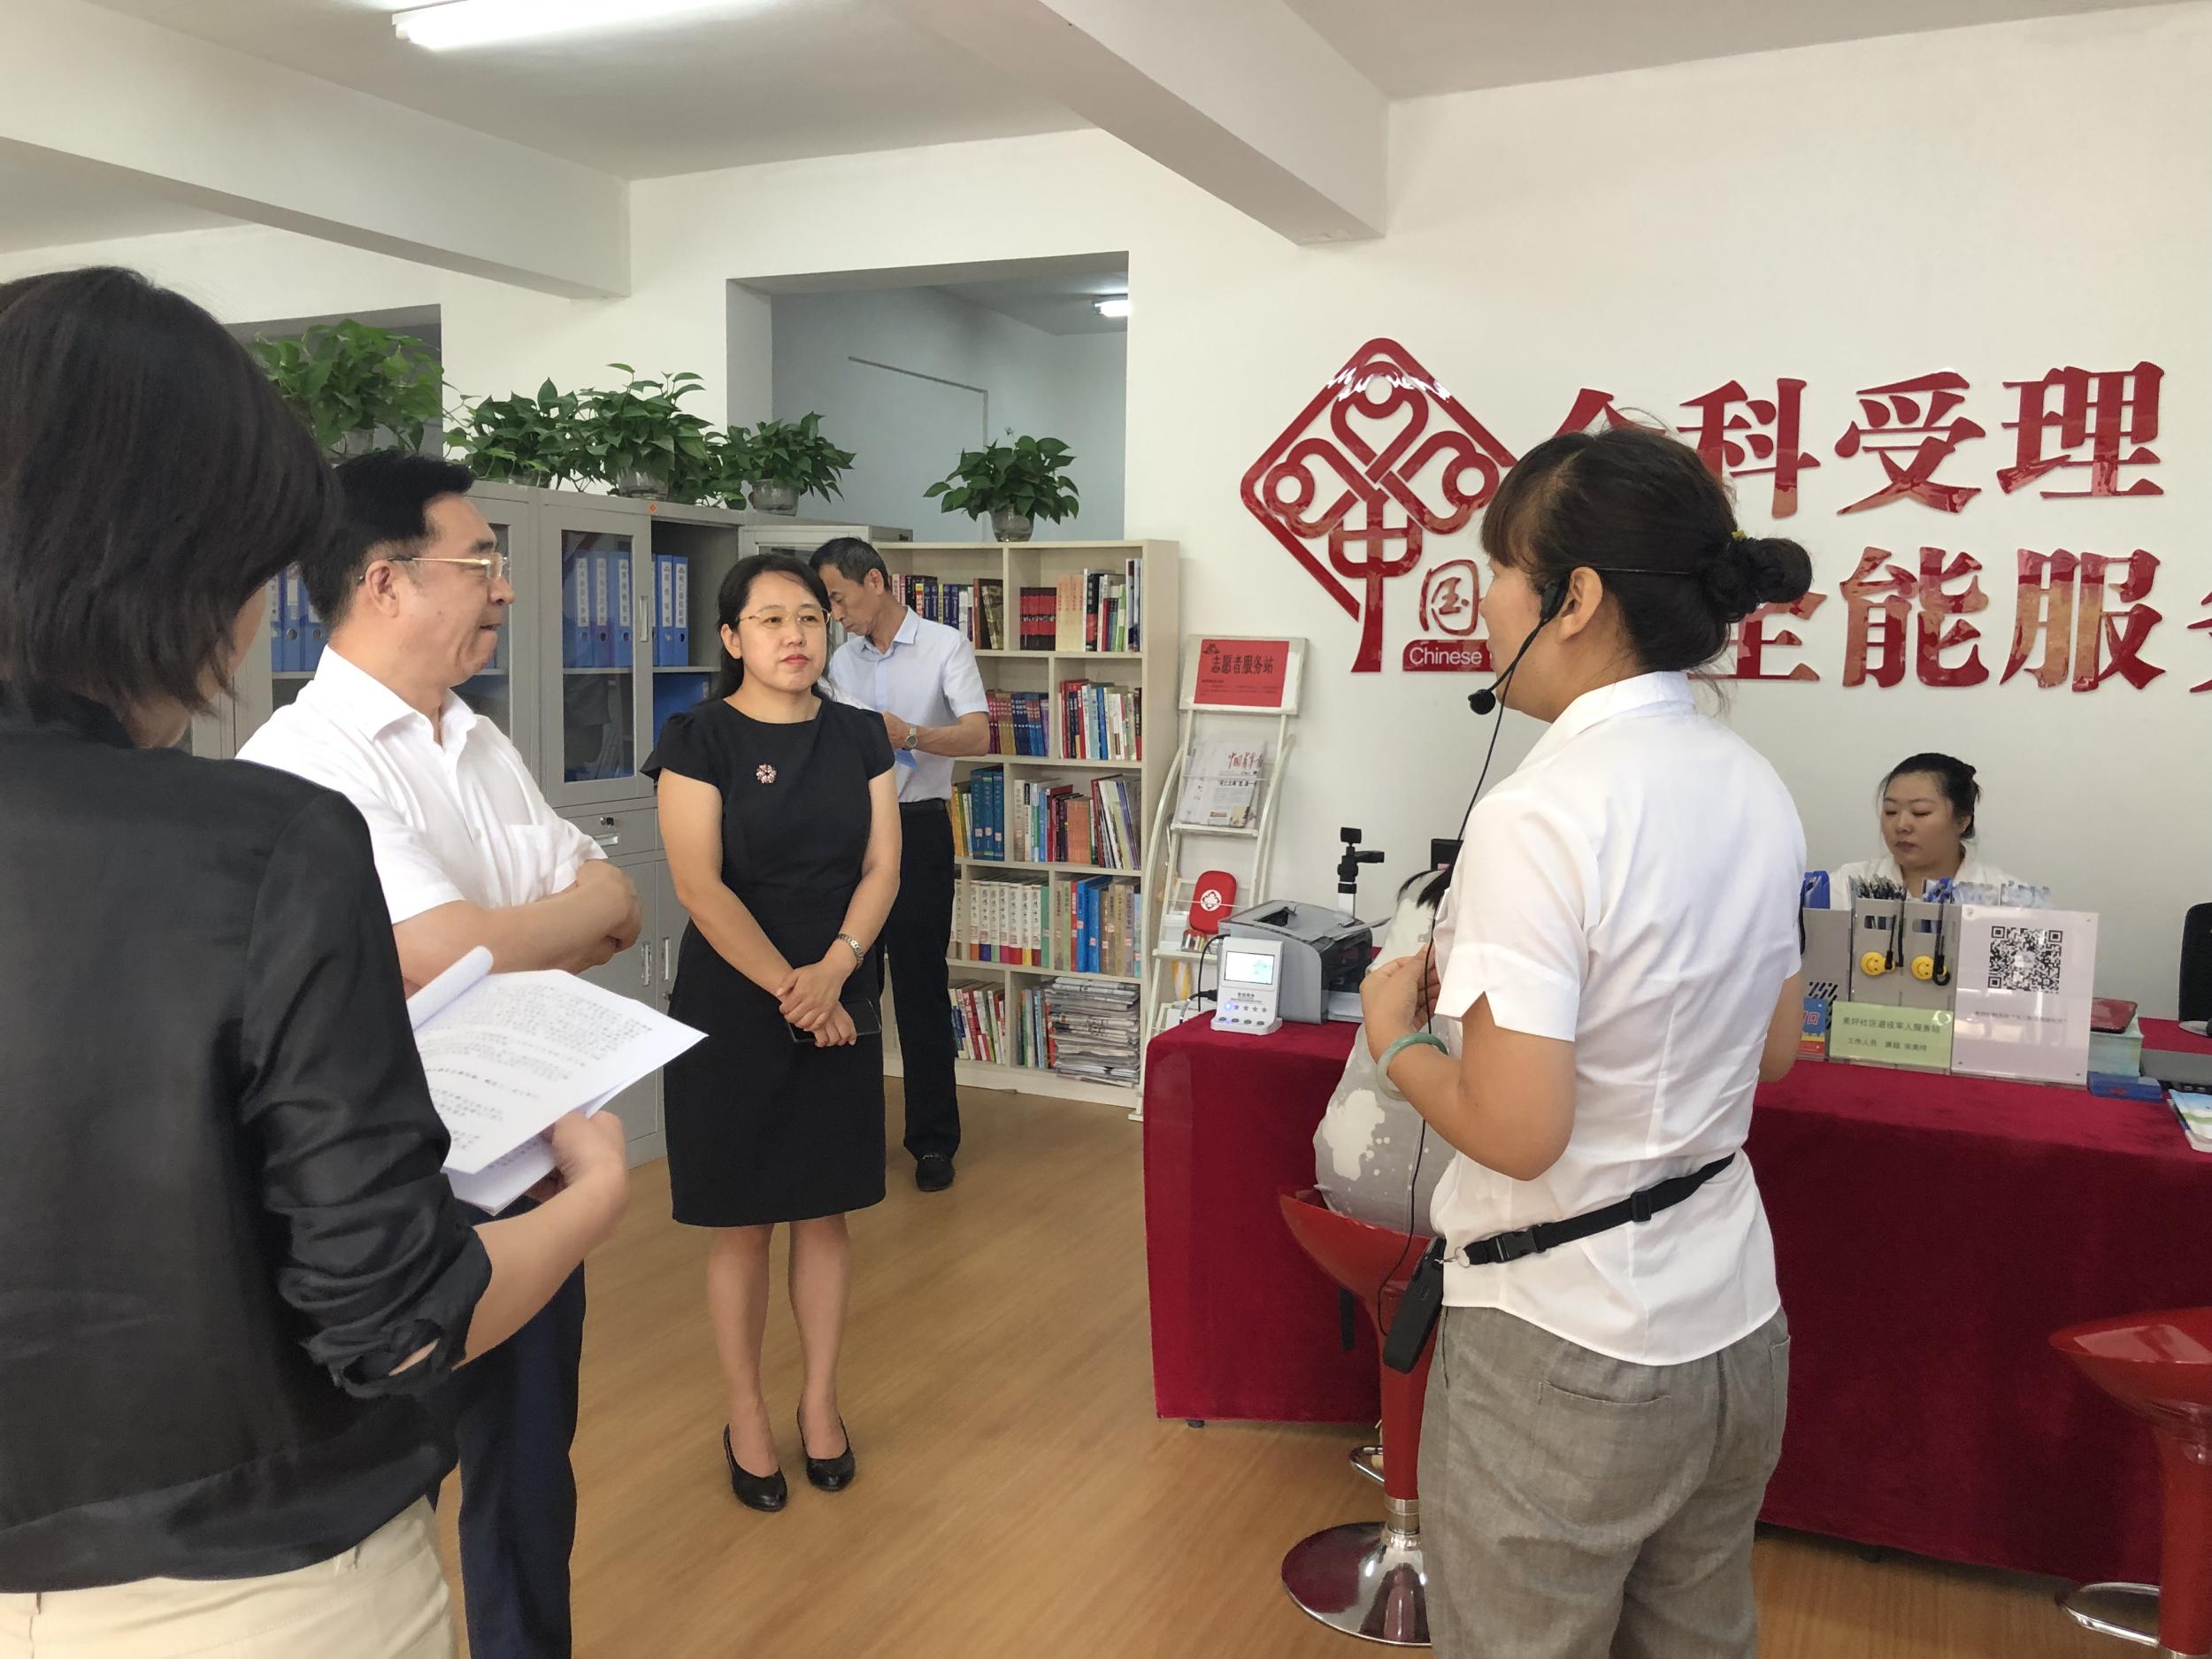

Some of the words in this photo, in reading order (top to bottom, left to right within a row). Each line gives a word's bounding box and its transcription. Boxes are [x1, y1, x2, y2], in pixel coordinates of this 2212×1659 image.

[1409, 647, 1482, 664] Chinese
[1210, 655, 1274, 674] 志愿者服务站
[1842, 1017, 1941, 1033] 美好社区退役军人服务站
[1847, 1037, 1877, 1047] 工作人员
